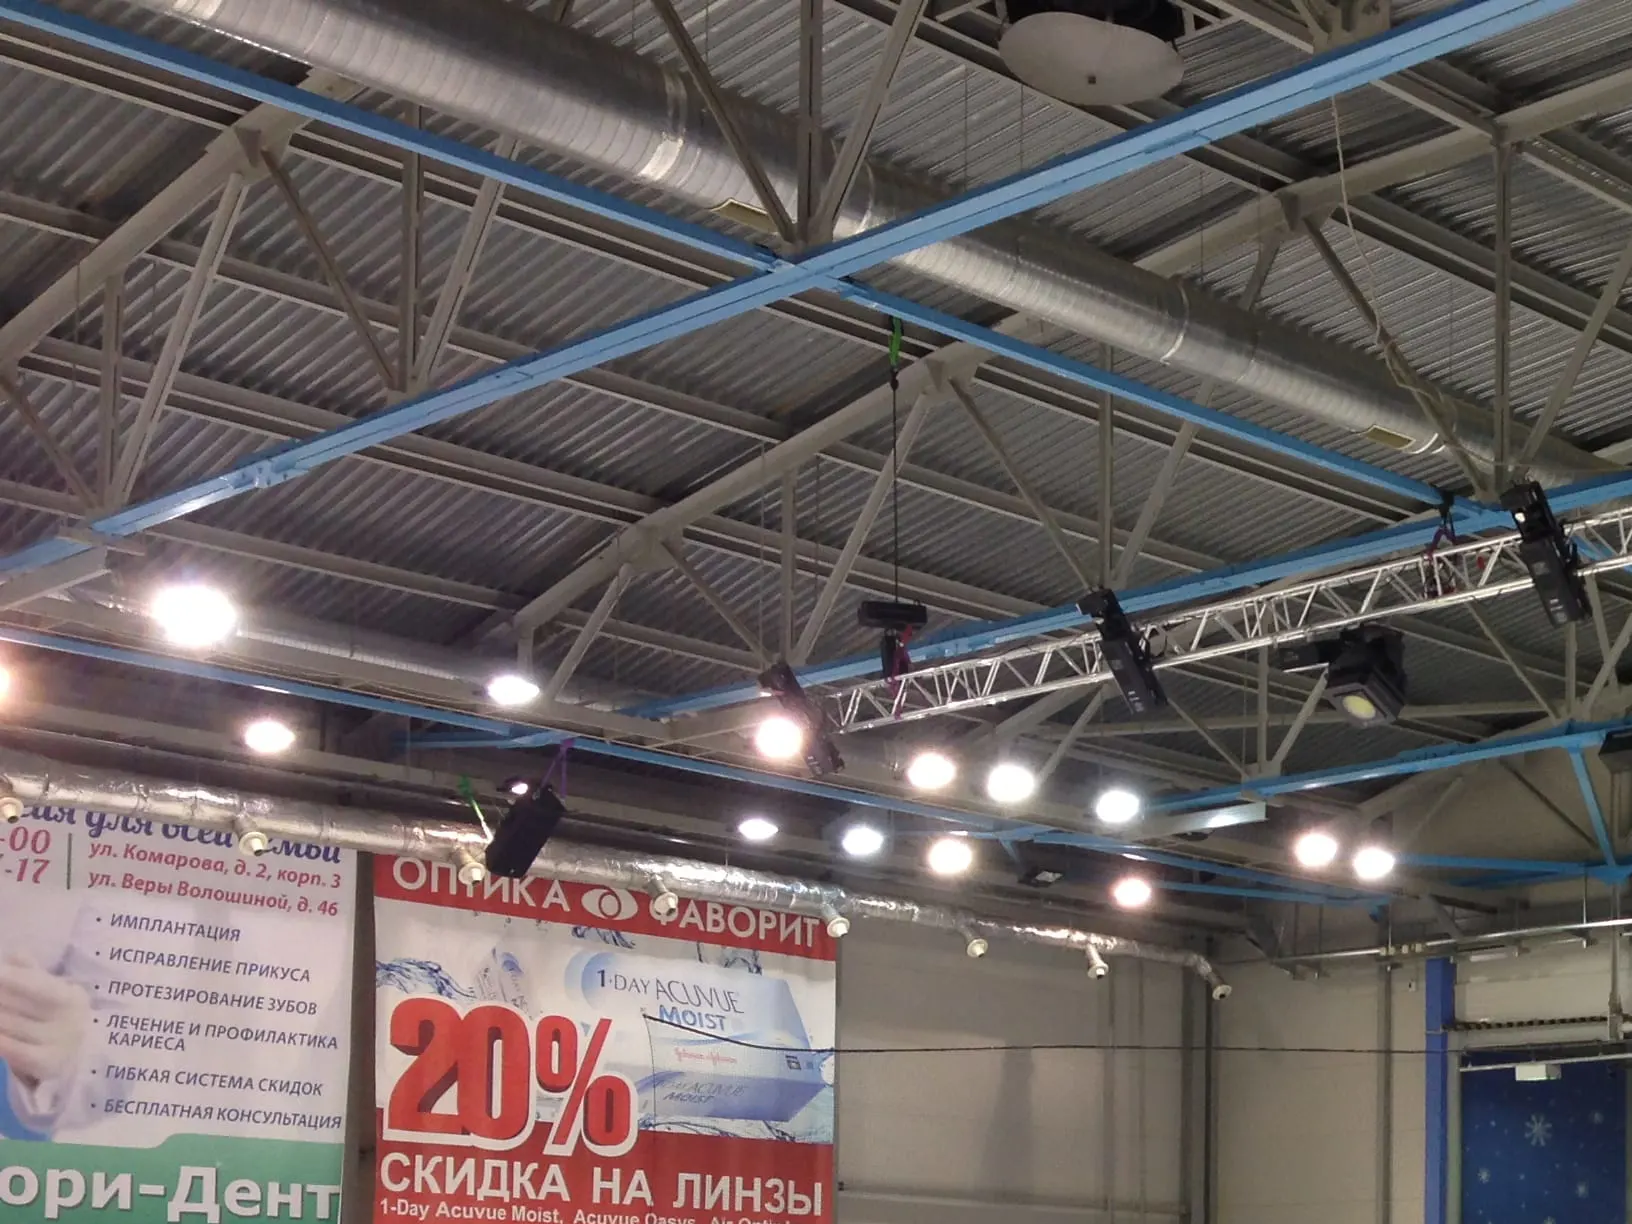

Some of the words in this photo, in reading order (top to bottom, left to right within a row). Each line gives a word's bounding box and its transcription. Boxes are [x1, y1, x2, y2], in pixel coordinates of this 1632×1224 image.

[88, 842, 118, 859] ул.
[123, 843, 229, 875] Комарова,
[233, 859, 251, 876] д.
[255, 862, 272, 881] 2,
[277, 867, 326, 889] корп.
[330, 873, 342, 889] 3
[88, 871, 117, 888] ул.
[122, 872, 173, 896] Веры
[177, 880, 292, 913] Волошиной,
[296, 896, 312, 913] д.
[317, 900, 339, 917] 46
[110, 913, 242, 942] ИМПЛАНТАЦИЯ
[109, 947, 234, 976] ИСПРАВЛЕНИЕ
[235, 961, 311, 984] ПРИКУСА
[108, 980, 265, 1011] ПРОТЕЗИРОВАНИЕ
[268, 997, 318, 1017] ЗУБОВ
[655, 978, 745, 1015] ACUVUE
[106, 1014, 186, 1036] ЛЕЧЕНИЕ
[189, 1020, 201, 1037] И
[204, 1023, 338, 1050] ПРОФИЛАКТИКА
[658, 1004, 727, 1032] MOIST
[107, 1032, 186, 1052] КАРИЕСА
[105, 1064, 171, 1085] ГИБКАЯ
[174, 1070, 254, 1091] СИСТЕМА
[258, 1077, 323, 1098] СКИДОК
[382, 996, 639, 1157] 20%
[103, 1098, 214, 1122] БЕСПЛАТНАЯ
[216, 1106, 343, 1131] КОНСУЛЬТАЦИЯ
[380, 1152, 570, 1202] СКИДКА
[592, 1166, 655, 1208] НА
[673, 1172, 823, 1216] ЛИНЗЫ
[380, 1198, 431, 1222] 1-Day
[434, 1203, 508, 1223] Acuvue
